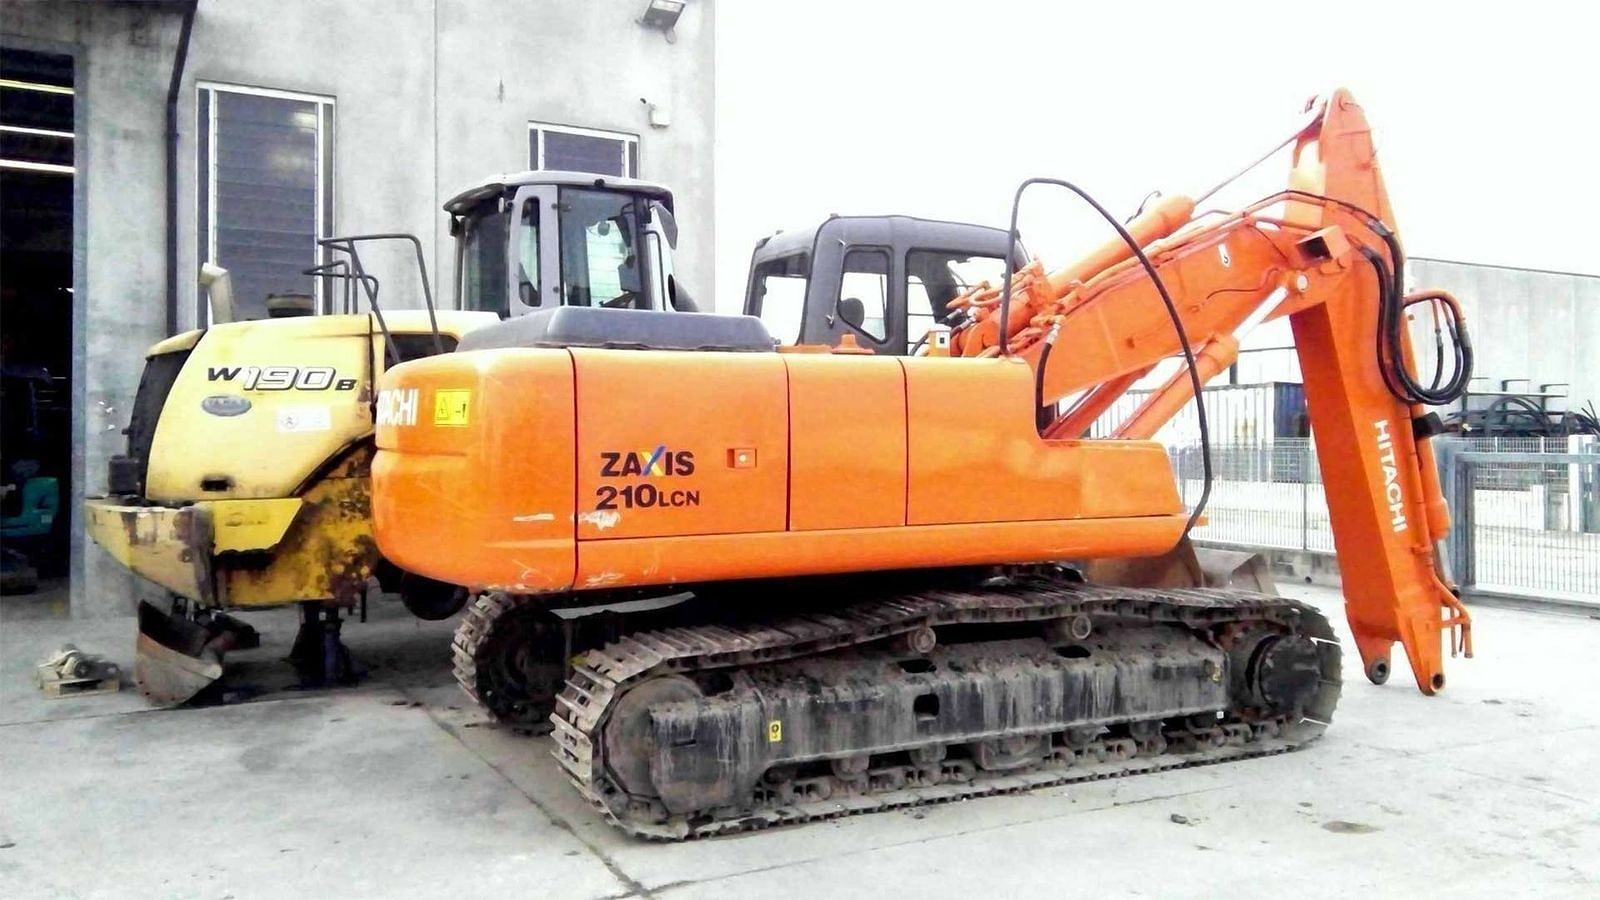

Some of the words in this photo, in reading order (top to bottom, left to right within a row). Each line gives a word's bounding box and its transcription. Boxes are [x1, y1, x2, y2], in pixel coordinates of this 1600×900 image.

[600, 444, 695, 477] ZAXIS
[1374, 419, 1408, 532] HITACHI
[595, 483, 699, 510] 210LCN
